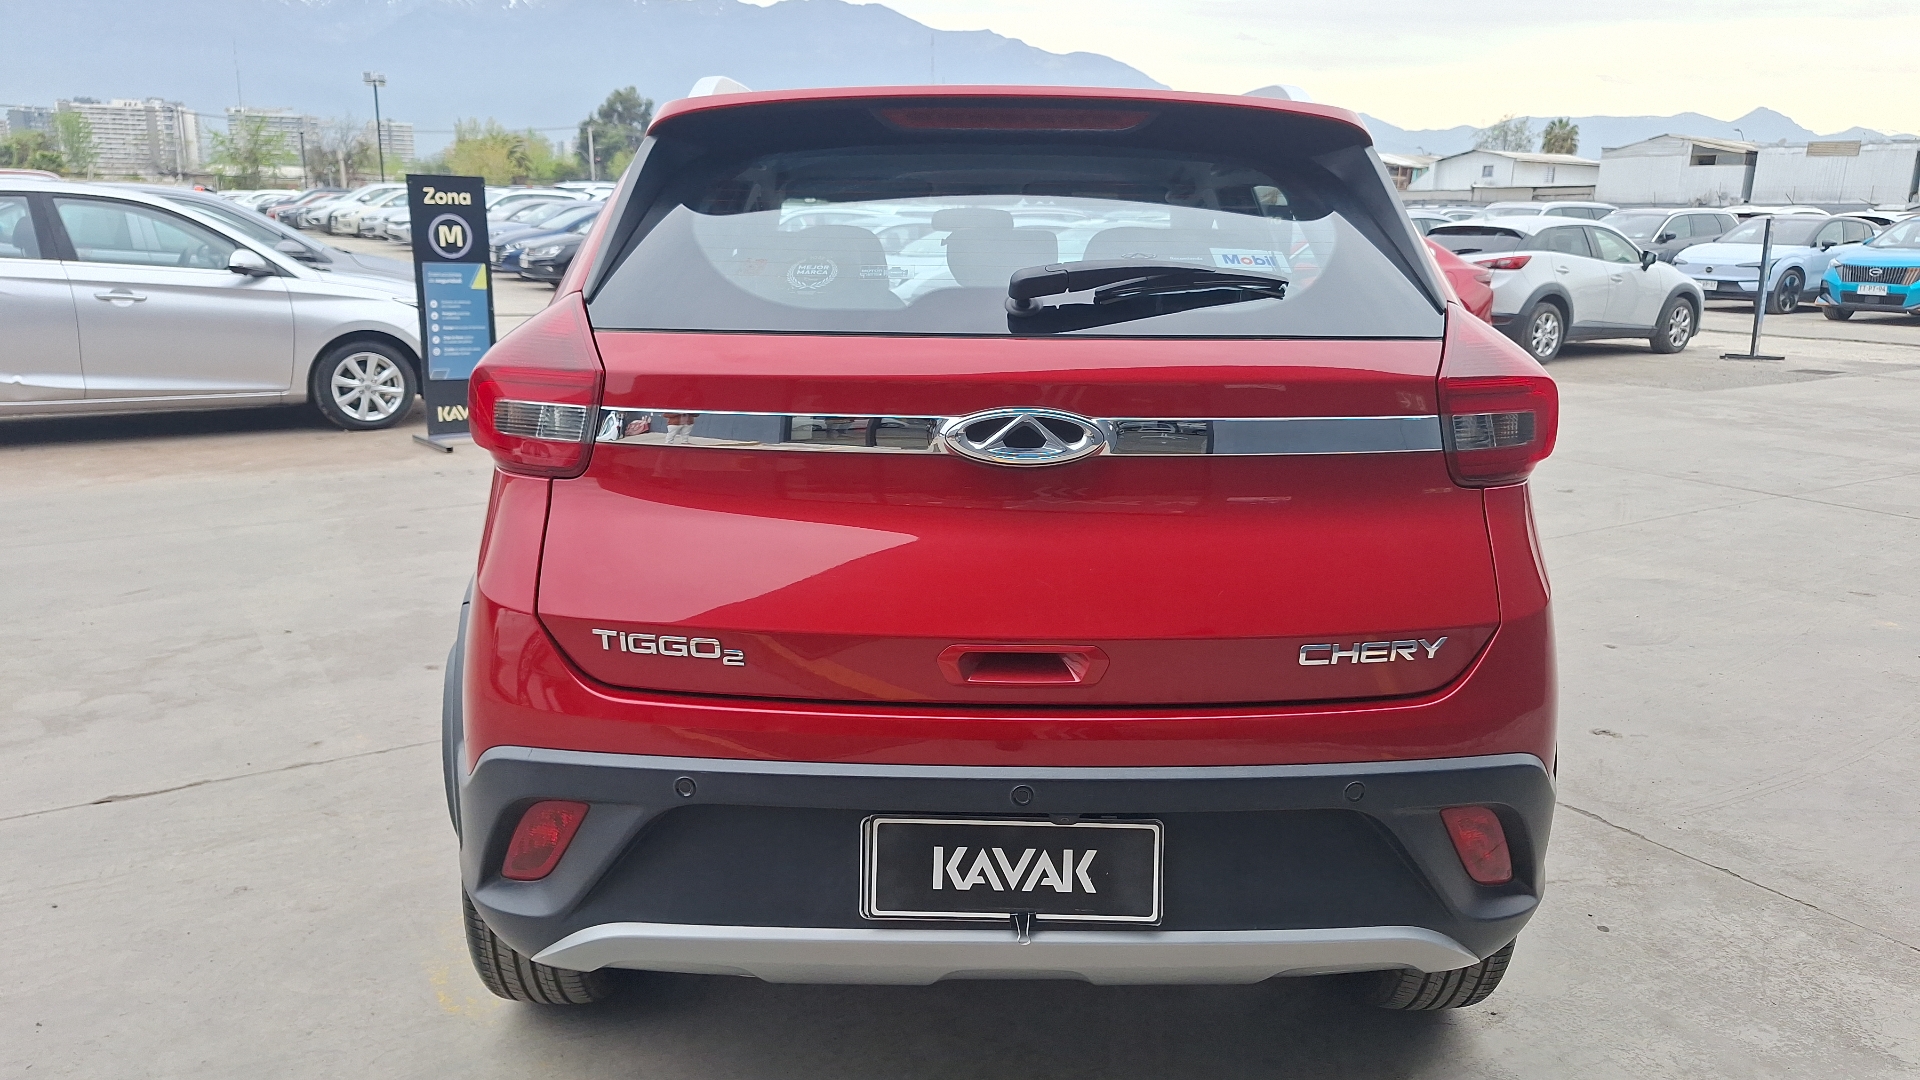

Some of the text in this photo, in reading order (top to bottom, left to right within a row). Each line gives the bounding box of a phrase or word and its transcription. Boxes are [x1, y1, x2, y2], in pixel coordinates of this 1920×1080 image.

[422, 186, 472, 206] Zona
[438, 224, 464, 248] M
[1221, 254, 1277, 267] Mobil
[437, 405, 469, 422] KAV
[1298, 636, 1448, 666] CHERY
[932, 846, 1098, 894] KAVAK
